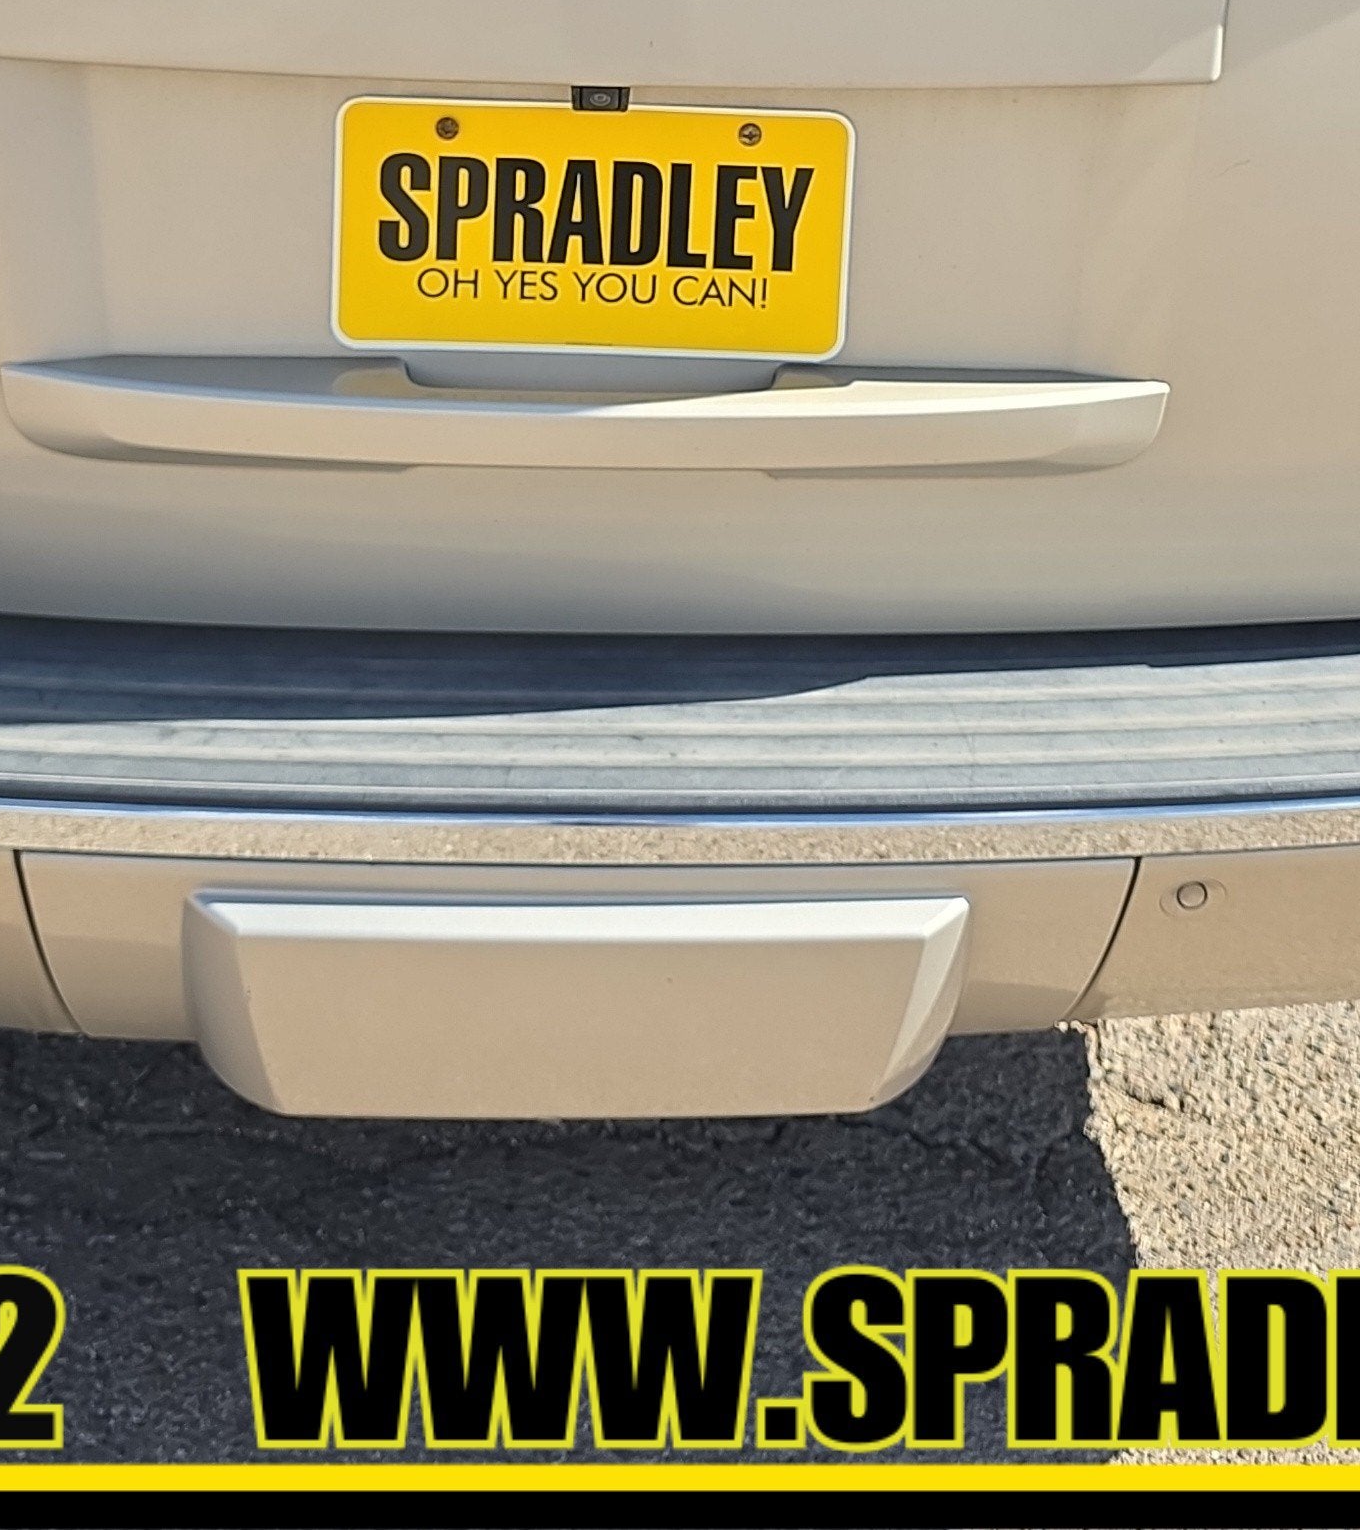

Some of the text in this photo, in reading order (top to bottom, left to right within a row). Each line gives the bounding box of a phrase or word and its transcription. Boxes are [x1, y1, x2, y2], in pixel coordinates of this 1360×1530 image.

[377, 152, 816, 273] SPRADLEY
[417, 267, 768, 310] OH YES YOU CAN!
